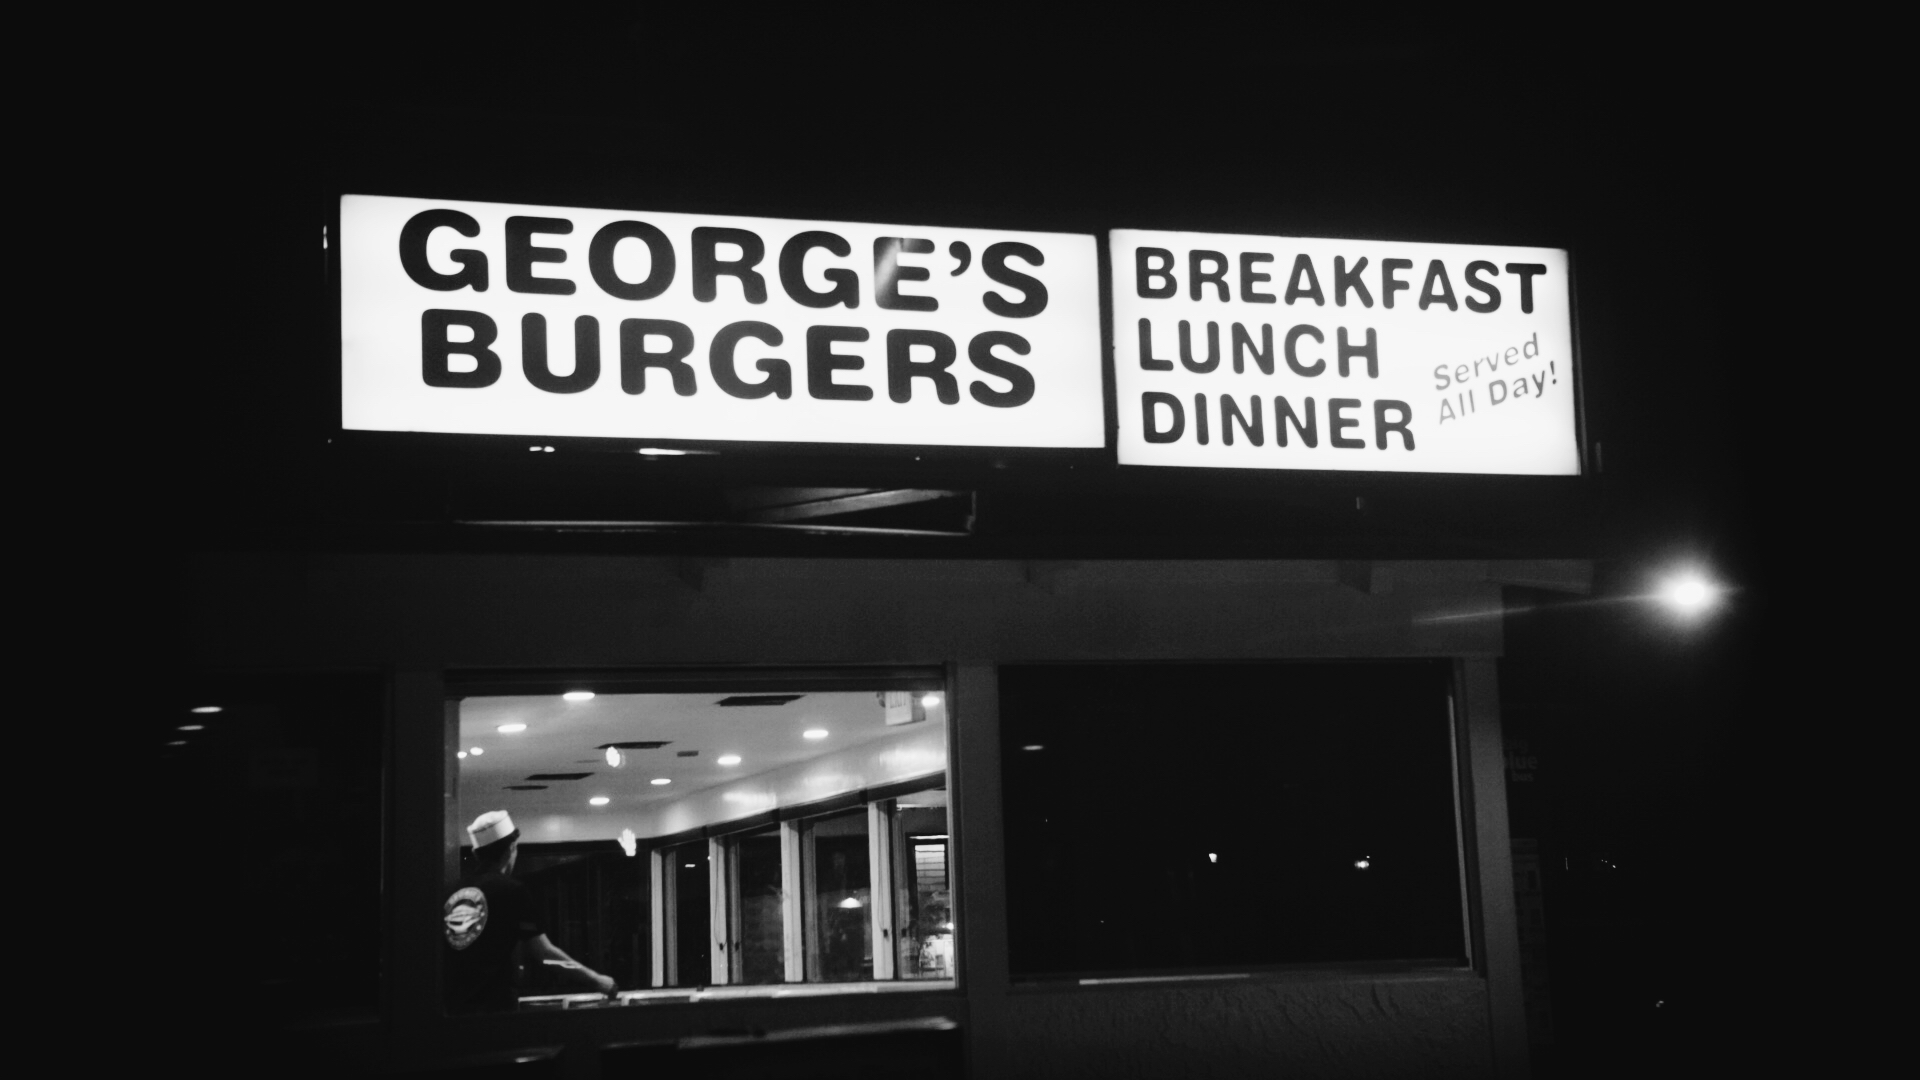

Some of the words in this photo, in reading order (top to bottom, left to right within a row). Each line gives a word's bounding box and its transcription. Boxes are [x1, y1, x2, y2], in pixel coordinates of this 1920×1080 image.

[399, 208, 1049, 319] GEORGE'S
[1136, 246, 1547, 315] BREAKFAST
[421, 308, 1036, 408] BURGERS
[1138, 317, 1379, 378] LUNCH
[1433, 331, 1539, 391] Served
[1141, 391, 1415, 451] DINNER
[1439, 389, 1475, 425] All
[1488, 360, 1557, 406] Day!
